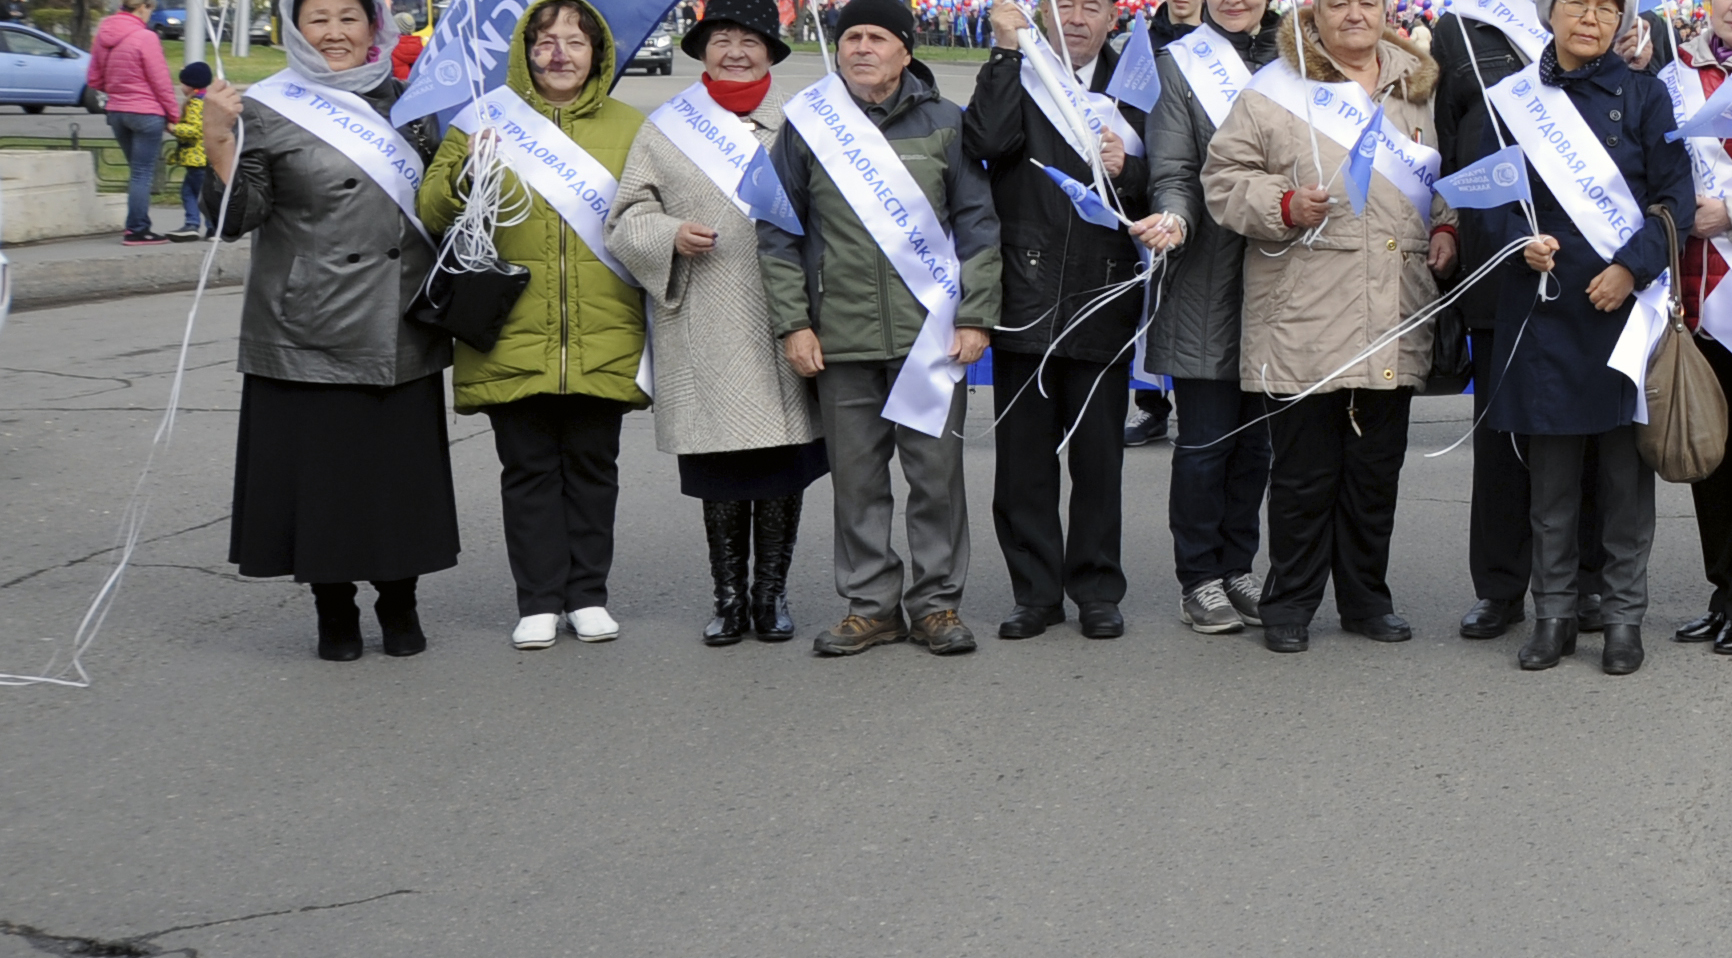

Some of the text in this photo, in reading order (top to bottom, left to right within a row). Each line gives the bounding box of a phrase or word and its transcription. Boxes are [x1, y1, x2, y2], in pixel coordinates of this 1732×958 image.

[309, 94, 397, 158] ТРУДОВАЯ
[503, 120, 577, 181] ТРУДОВАЯ
[674, 98, 736, 156] ТРУДОВАЯ
[1337, 100, 1415, 168] ТРУОВАЯ
[1525, 95, 1634, 241] ТРУДОВАЯ ДОБЛЕС
[843, 148, 909, 228] ДОБЛЕСТЬ
[904, 224, 958, 300] ХАКАСИИ
